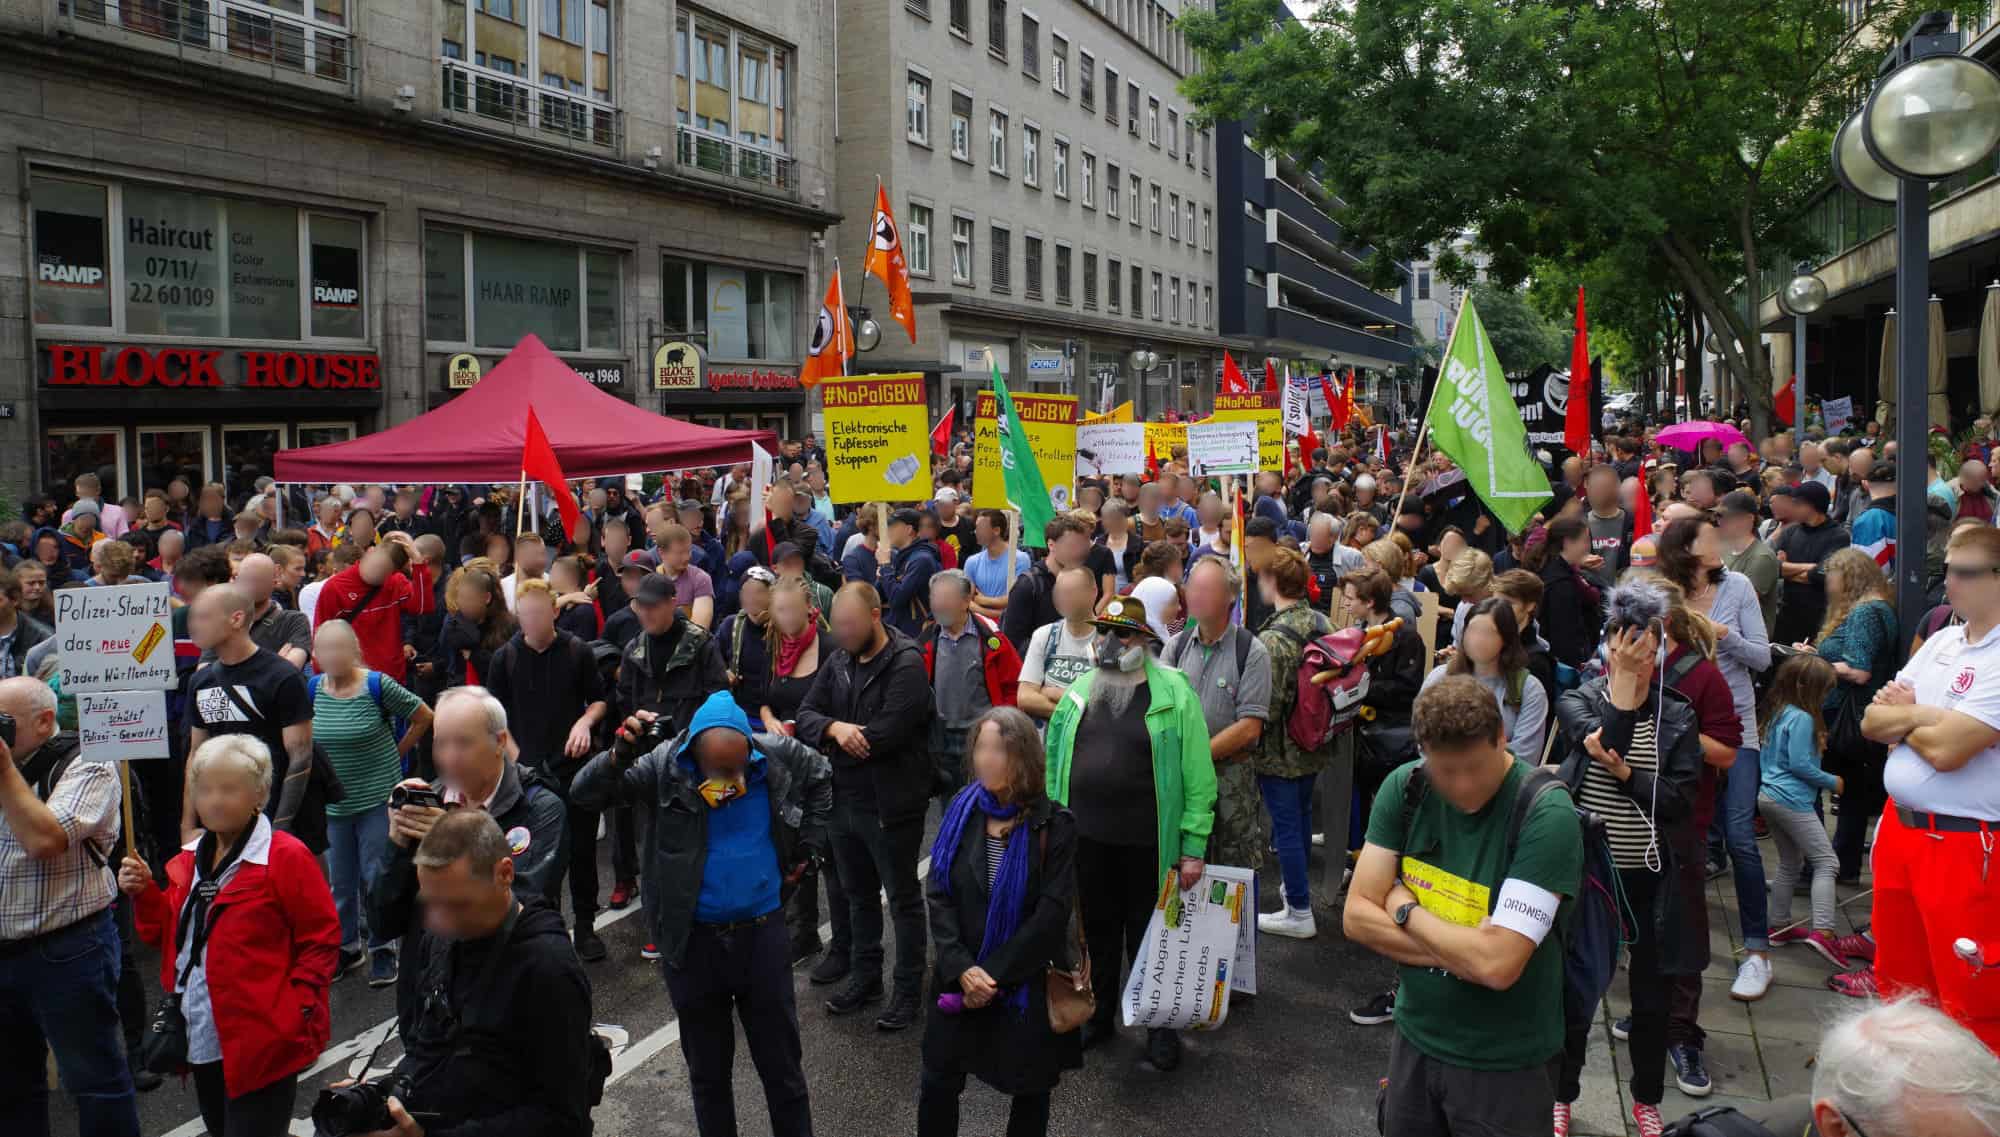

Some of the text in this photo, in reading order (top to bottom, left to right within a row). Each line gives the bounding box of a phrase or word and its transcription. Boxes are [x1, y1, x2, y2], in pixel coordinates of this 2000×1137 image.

[129, 218, 213, 251] Haircut
[232, 232, 254, 246] Cut
[233, 253, 264, 266] Color
[39, 263, 102, 284] RAMP
[145, 257, 198, 280] 0711/
[233, 272, 296, 288] Extensions
[314, 287, 358, 304] RAMP
[480, 280, 524, 305] HAAR
[530, 286, 571, 309] RAMP
[47, 344, 381, 390] BLOCK HOUSE
[597, 367, 620, 384] 1968
[660, 366, 695, 377] BLOCK
[660, 376, 695, 386] HOUSE
[824, 383, 919, 405] #NoPolGBW
[832, 419, 908, 435] Elektronische
[833, 436, 889, 452] Fußfesseln
[835, 453, 877, 470] stoppen
[58, 594, 168, 622] Polizei-Staat 21
[64, 632, 92, 652] das
[63, 669, 99, 686] Baden
[83, 696, 119, 714] Justiz
[1179, 891, 1197, 944] Lunge
[1153, 928, 1169, 985] Abgas
